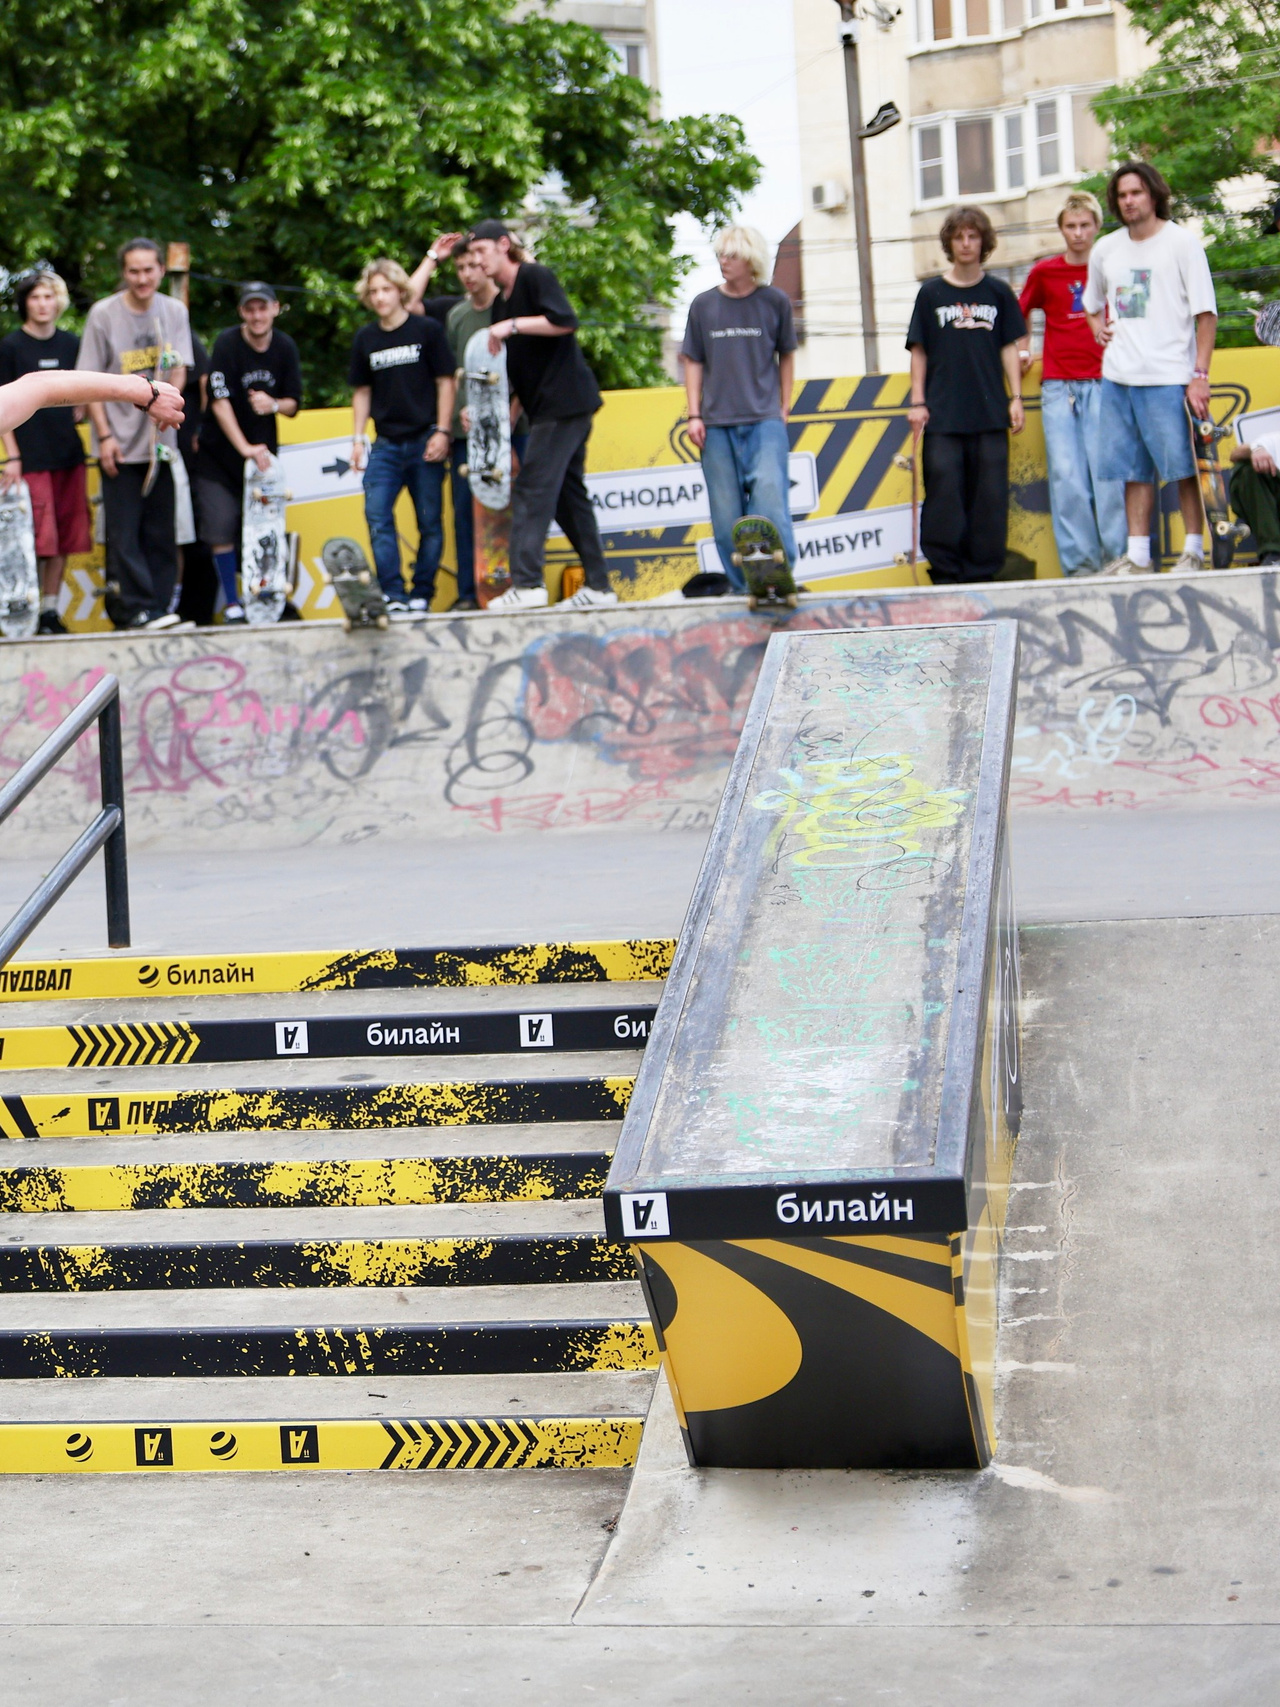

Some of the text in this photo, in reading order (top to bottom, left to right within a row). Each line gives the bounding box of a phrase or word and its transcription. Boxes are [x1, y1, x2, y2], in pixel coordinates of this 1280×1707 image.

[592, 483, 703, 509] АСНОДАР
[798, 528, 883, 559] ИНБУРГ
[168, 963, 254, 985] билайн
[367, 1022, 460, 1046] билайн
[776, 1192, 914, 1224] билайн
